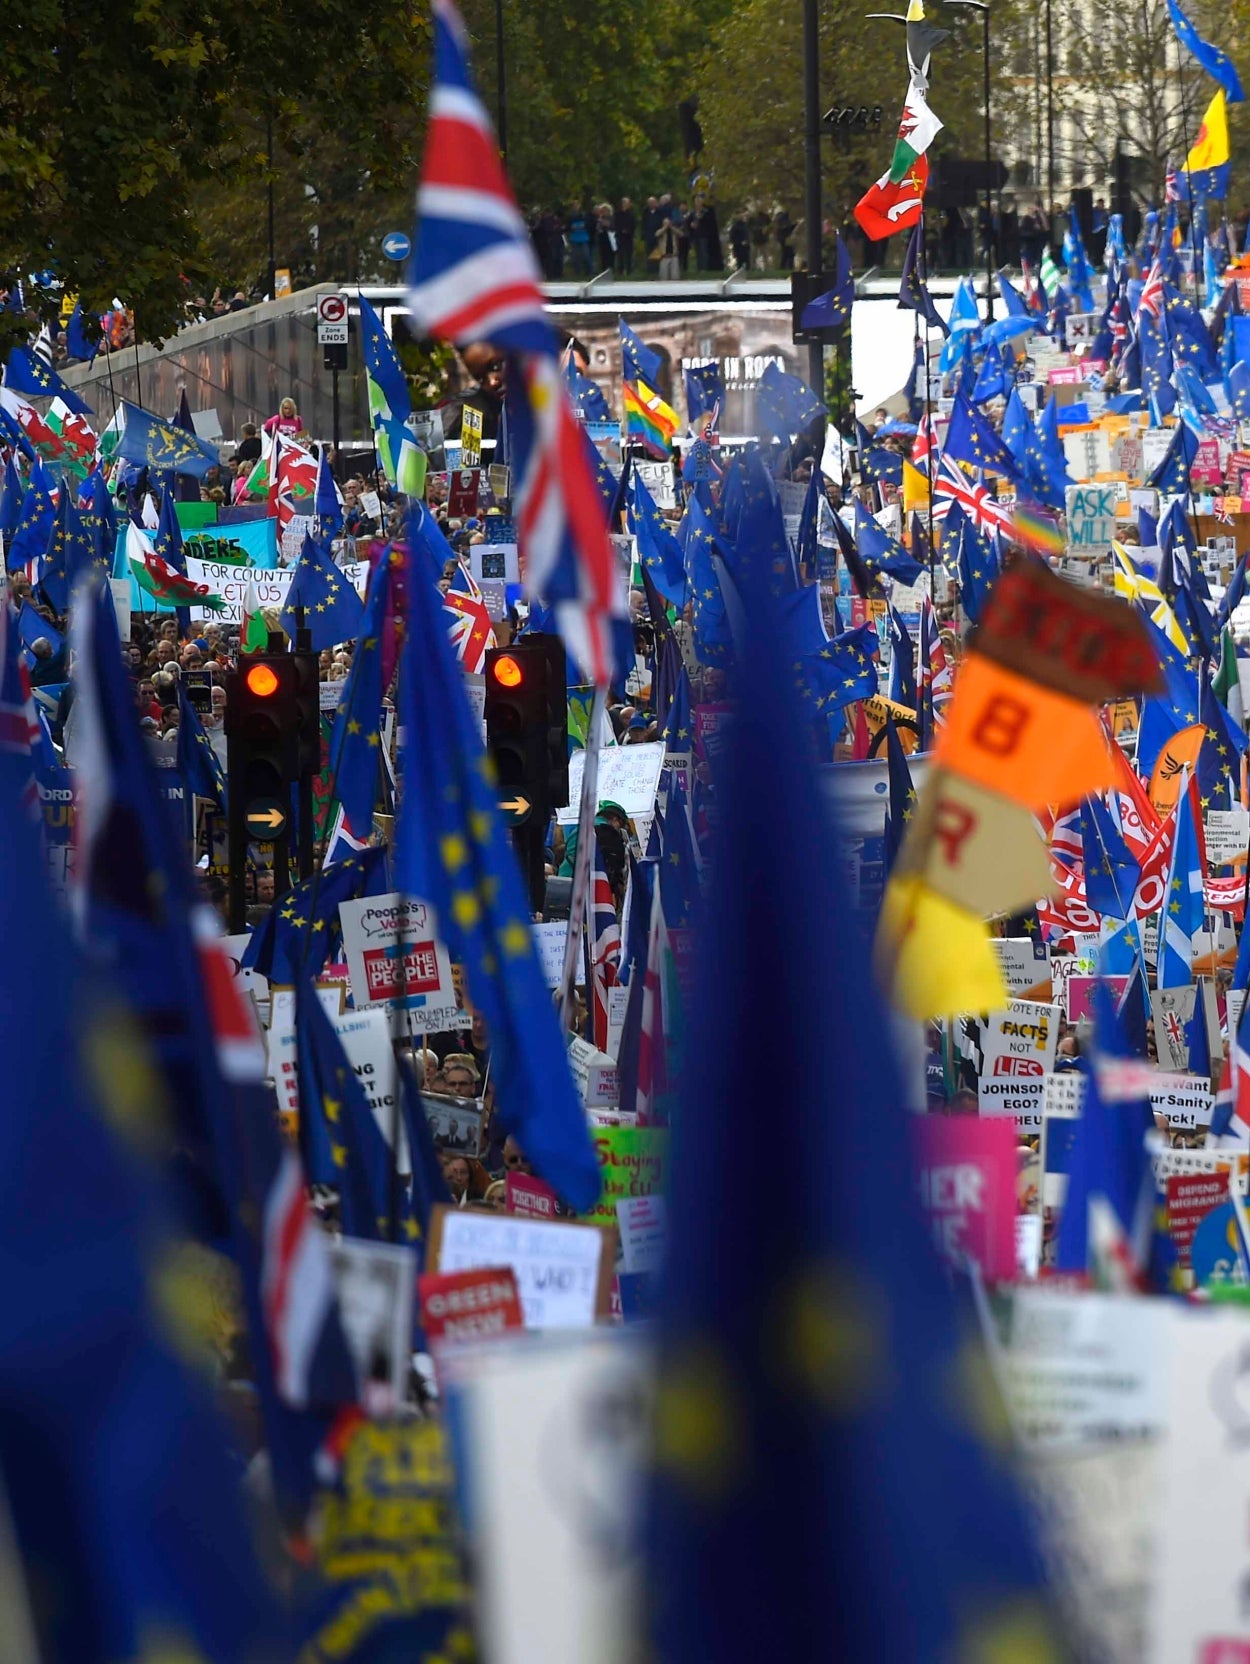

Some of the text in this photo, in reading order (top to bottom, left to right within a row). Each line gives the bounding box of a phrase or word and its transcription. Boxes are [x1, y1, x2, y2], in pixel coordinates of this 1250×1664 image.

[1072, 490, 1114, 518] ASK
[1069, 520, 1111, 545] WILL
[203, 563, 229, 578] FOR
[258, 585, 282, 602] US
[203, 604, 243, 622] BREXI
[1205, 829, 1241, 837] ironmental
[366, 903, 419, 920] People's
[410, 952, 433, 965] THE
[371, 964, 436, 988] PEOPLE
[1007, 1001, 1052, 1018] VOTE FOR
[1002, 1020, 1049, 1041] FACTS
[1009, 1042, 1032, 1053] NOT
[996, 1055, 1042, 1077] LIES
[1173, 1078, 1209, 1092] Want
[1003, 1099, 1039, 1109] EGO?
[1150, 1094, 1212, 1111] ur Sanity
[594, 1138, 662, 1179] Staying
[1177, 1182, 1220, 1197] DEFEND
[511, 1187, 551, 1212] TOGETHER
[426, 1280, 513, 1318] GREEN
[444, 1308, 507, 1338] NEW
